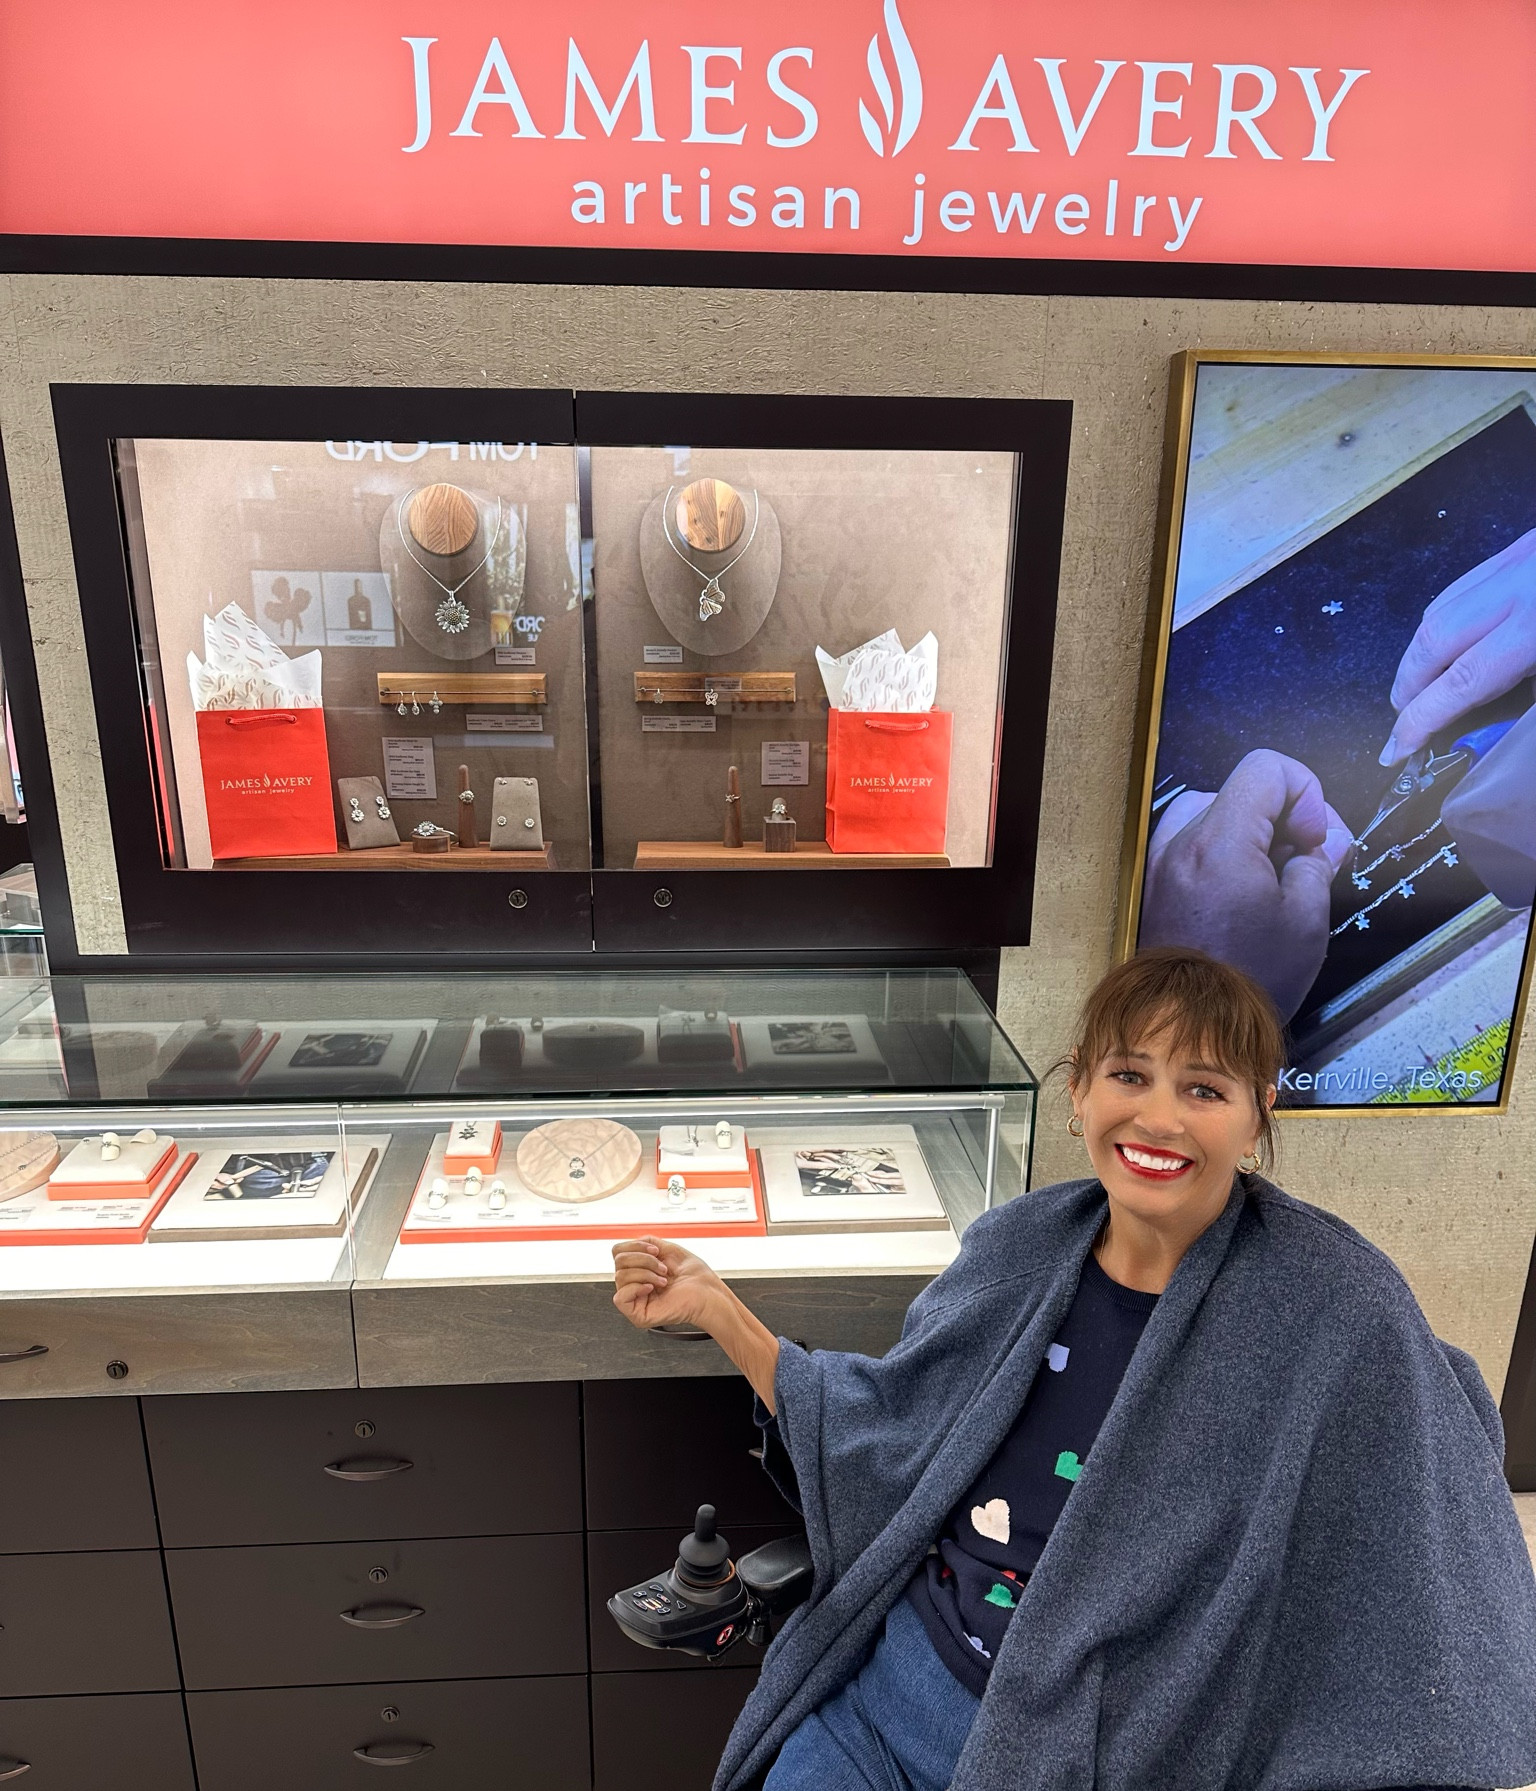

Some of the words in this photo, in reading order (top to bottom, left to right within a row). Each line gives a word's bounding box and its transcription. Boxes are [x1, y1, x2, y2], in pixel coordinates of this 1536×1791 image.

[401, 37, 818, 152] JAMES
[947, 54, 1370, 161] AVERY
[571, 168, 859, 229] artisan
[903, 173, 1203, 251] jewelry
[220, 778, 260, 790] JAMES
[273, 776, 312, 787] AVERY
[850, 777, 886, 787] JAMES
[897, 777, 933, 787] AVERY
[1277, 1066, 1395, 1092] Kerrville,
[1406, 1066, 1482, 1089] Texas
